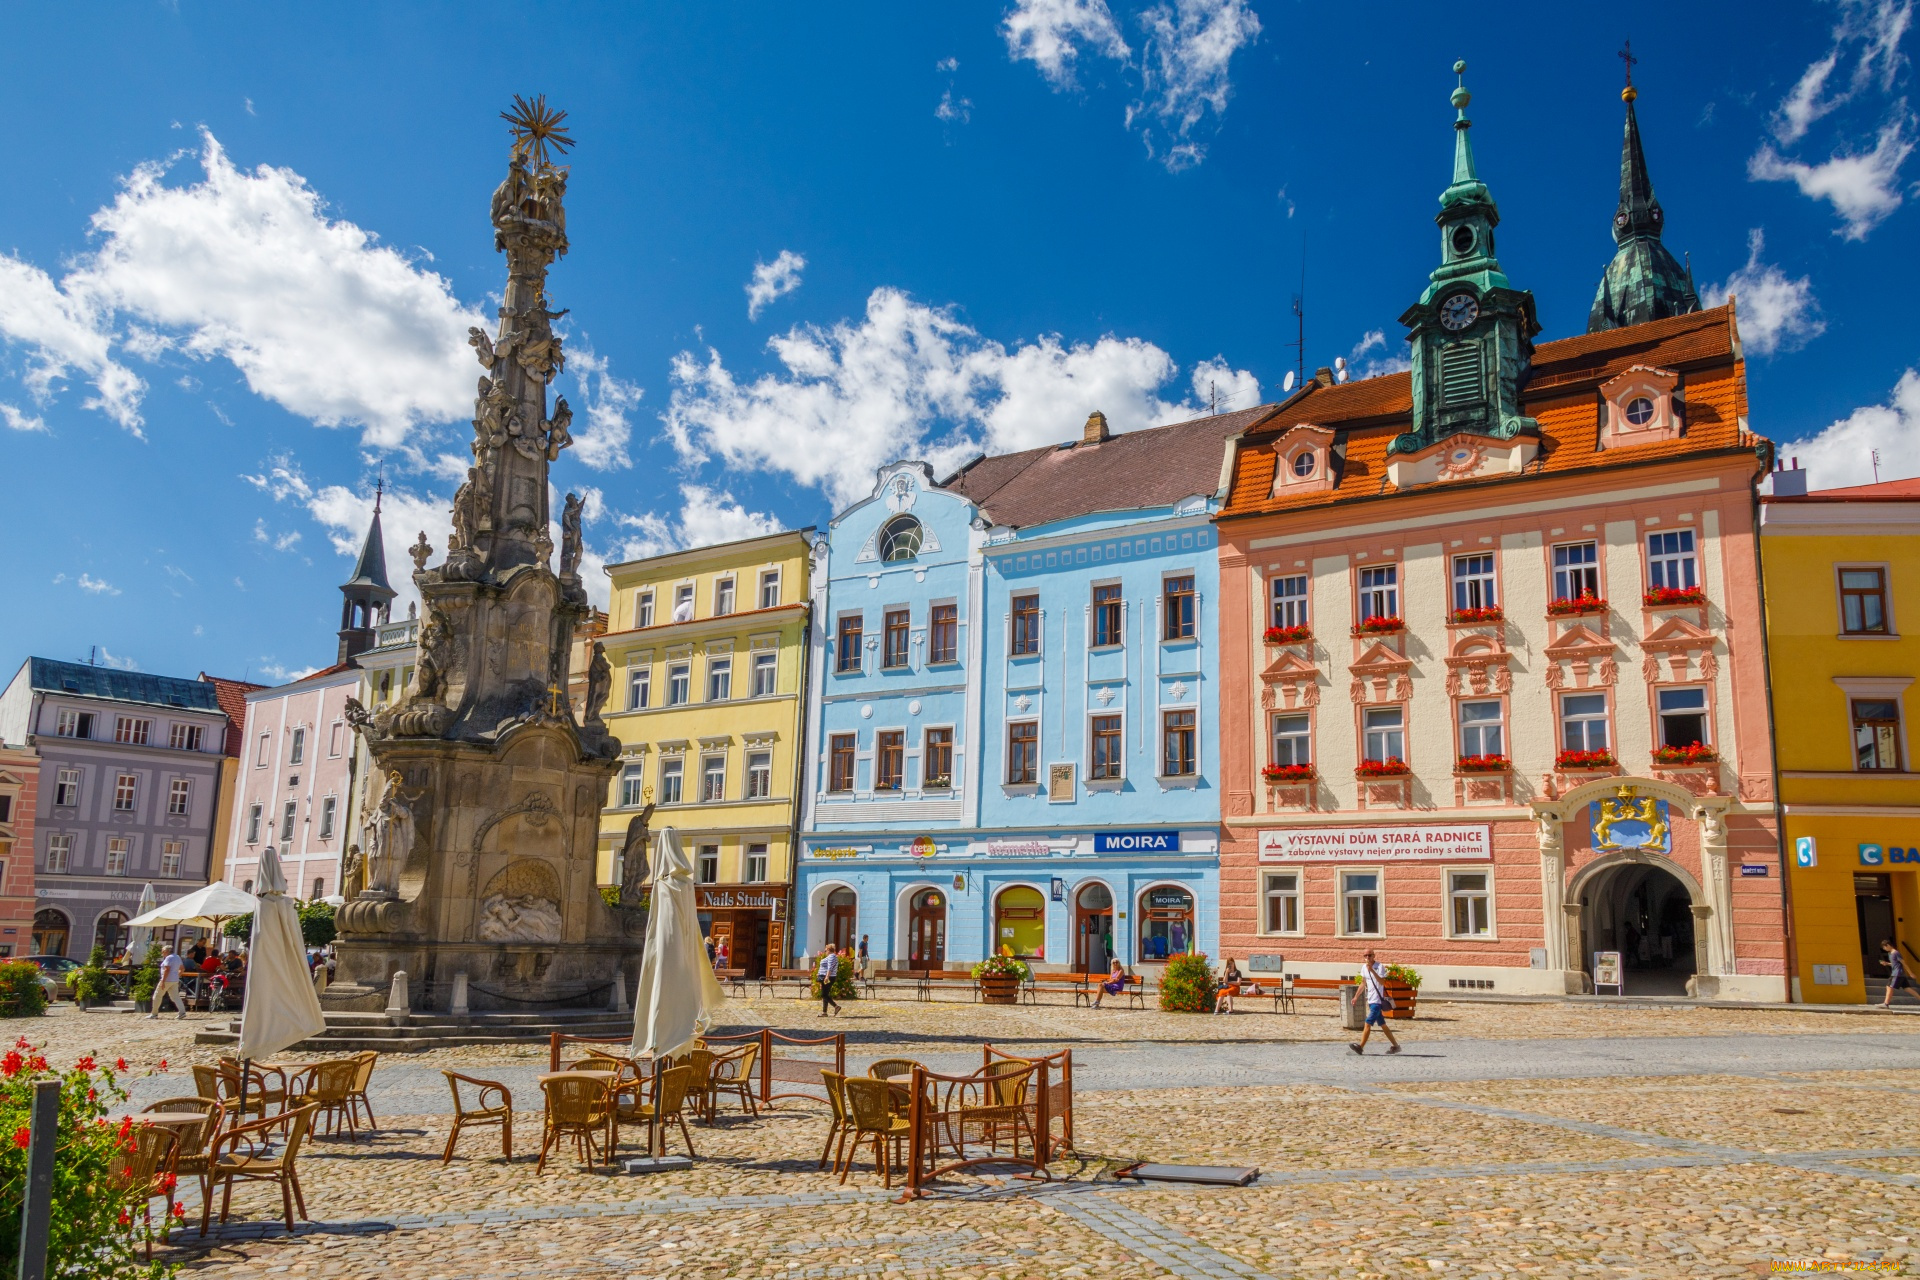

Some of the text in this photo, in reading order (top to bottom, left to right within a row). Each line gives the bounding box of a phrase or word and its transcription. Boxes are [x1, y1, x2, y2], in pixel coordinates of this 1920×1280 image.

[1106, 836, 1167, 849] MOIRA
[1288, 831, 1482, 845] VÝSTAVNÍ DŮM STARÁ RADNICE
[813, 846, 858, 861] drogerie
[913, 843, 933, 853] teta
[988, 841, 1050, 855] kosmetika
[1288, 848, 1326, 856] zábavné
[1328, 848, 1364, 858] výstavy
[1367, 847, 1392, 856] nejen
[1394, 847, 1411, 856] pro
[1413, 846, 1444, 855] rodiny
[1454, 845, 1483, 853] dětmi
[704, 891, 734, 906] Nails
